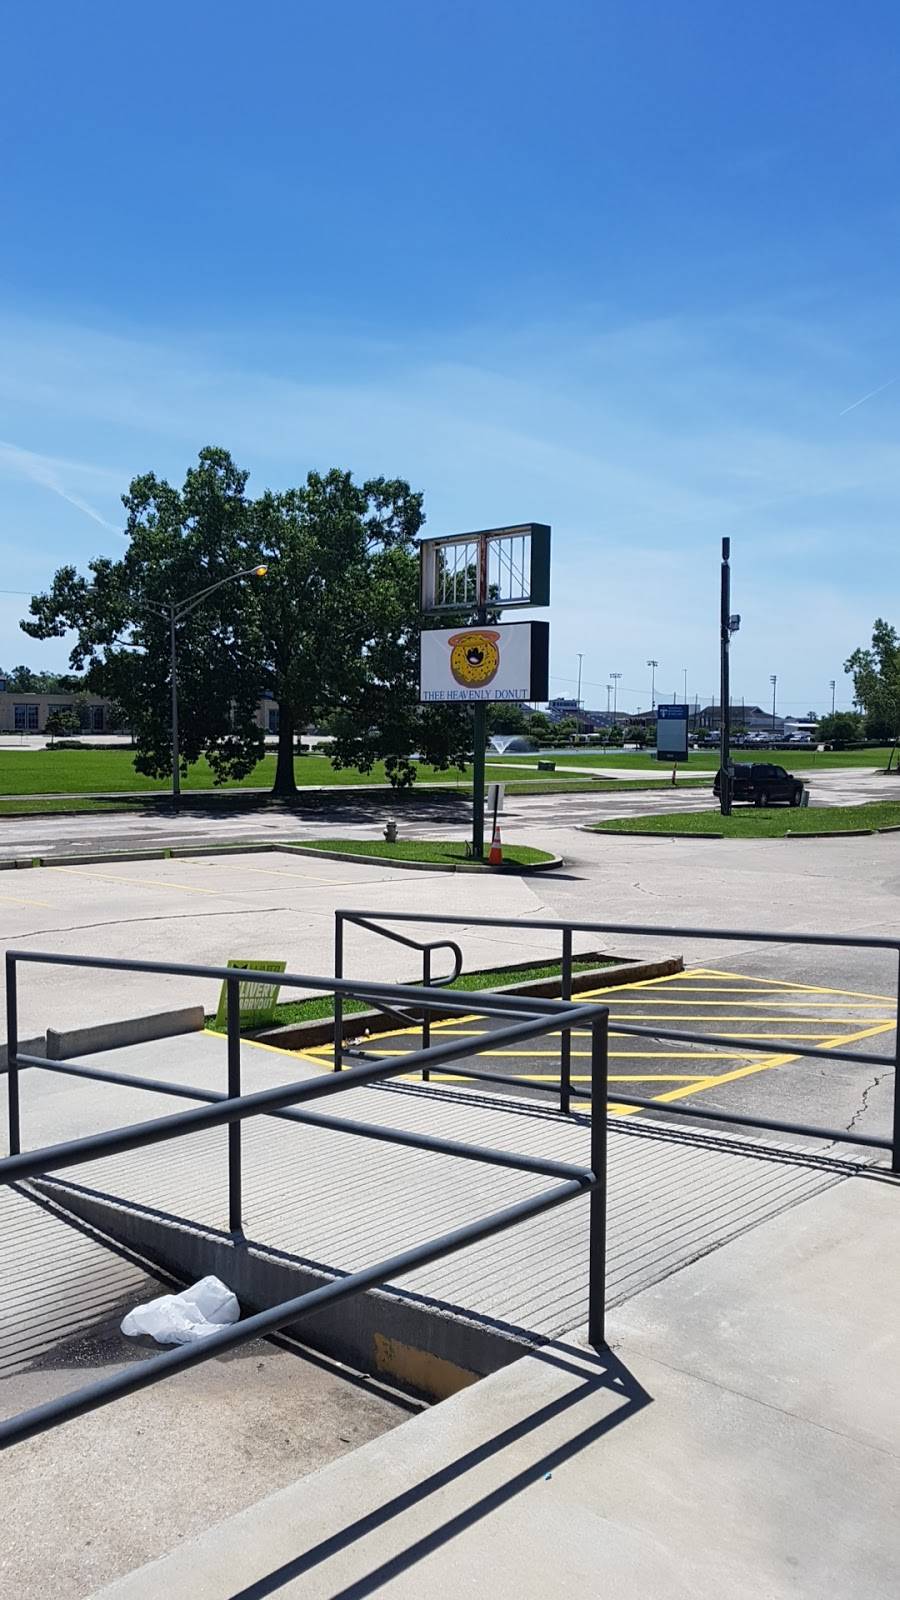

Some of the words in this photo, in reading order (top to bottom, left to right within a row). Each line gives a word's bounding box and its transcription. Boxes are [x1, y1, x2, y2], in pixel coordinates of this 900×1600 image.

[423, 690, 446, 700] THEE
[446, 689, 491, 700] HEAVENLY
[495, 689, 527, 699] DONUT
[239, 981, 276, 997] LIVERY
[239, 997, 273, 1010] ARRYOUT
